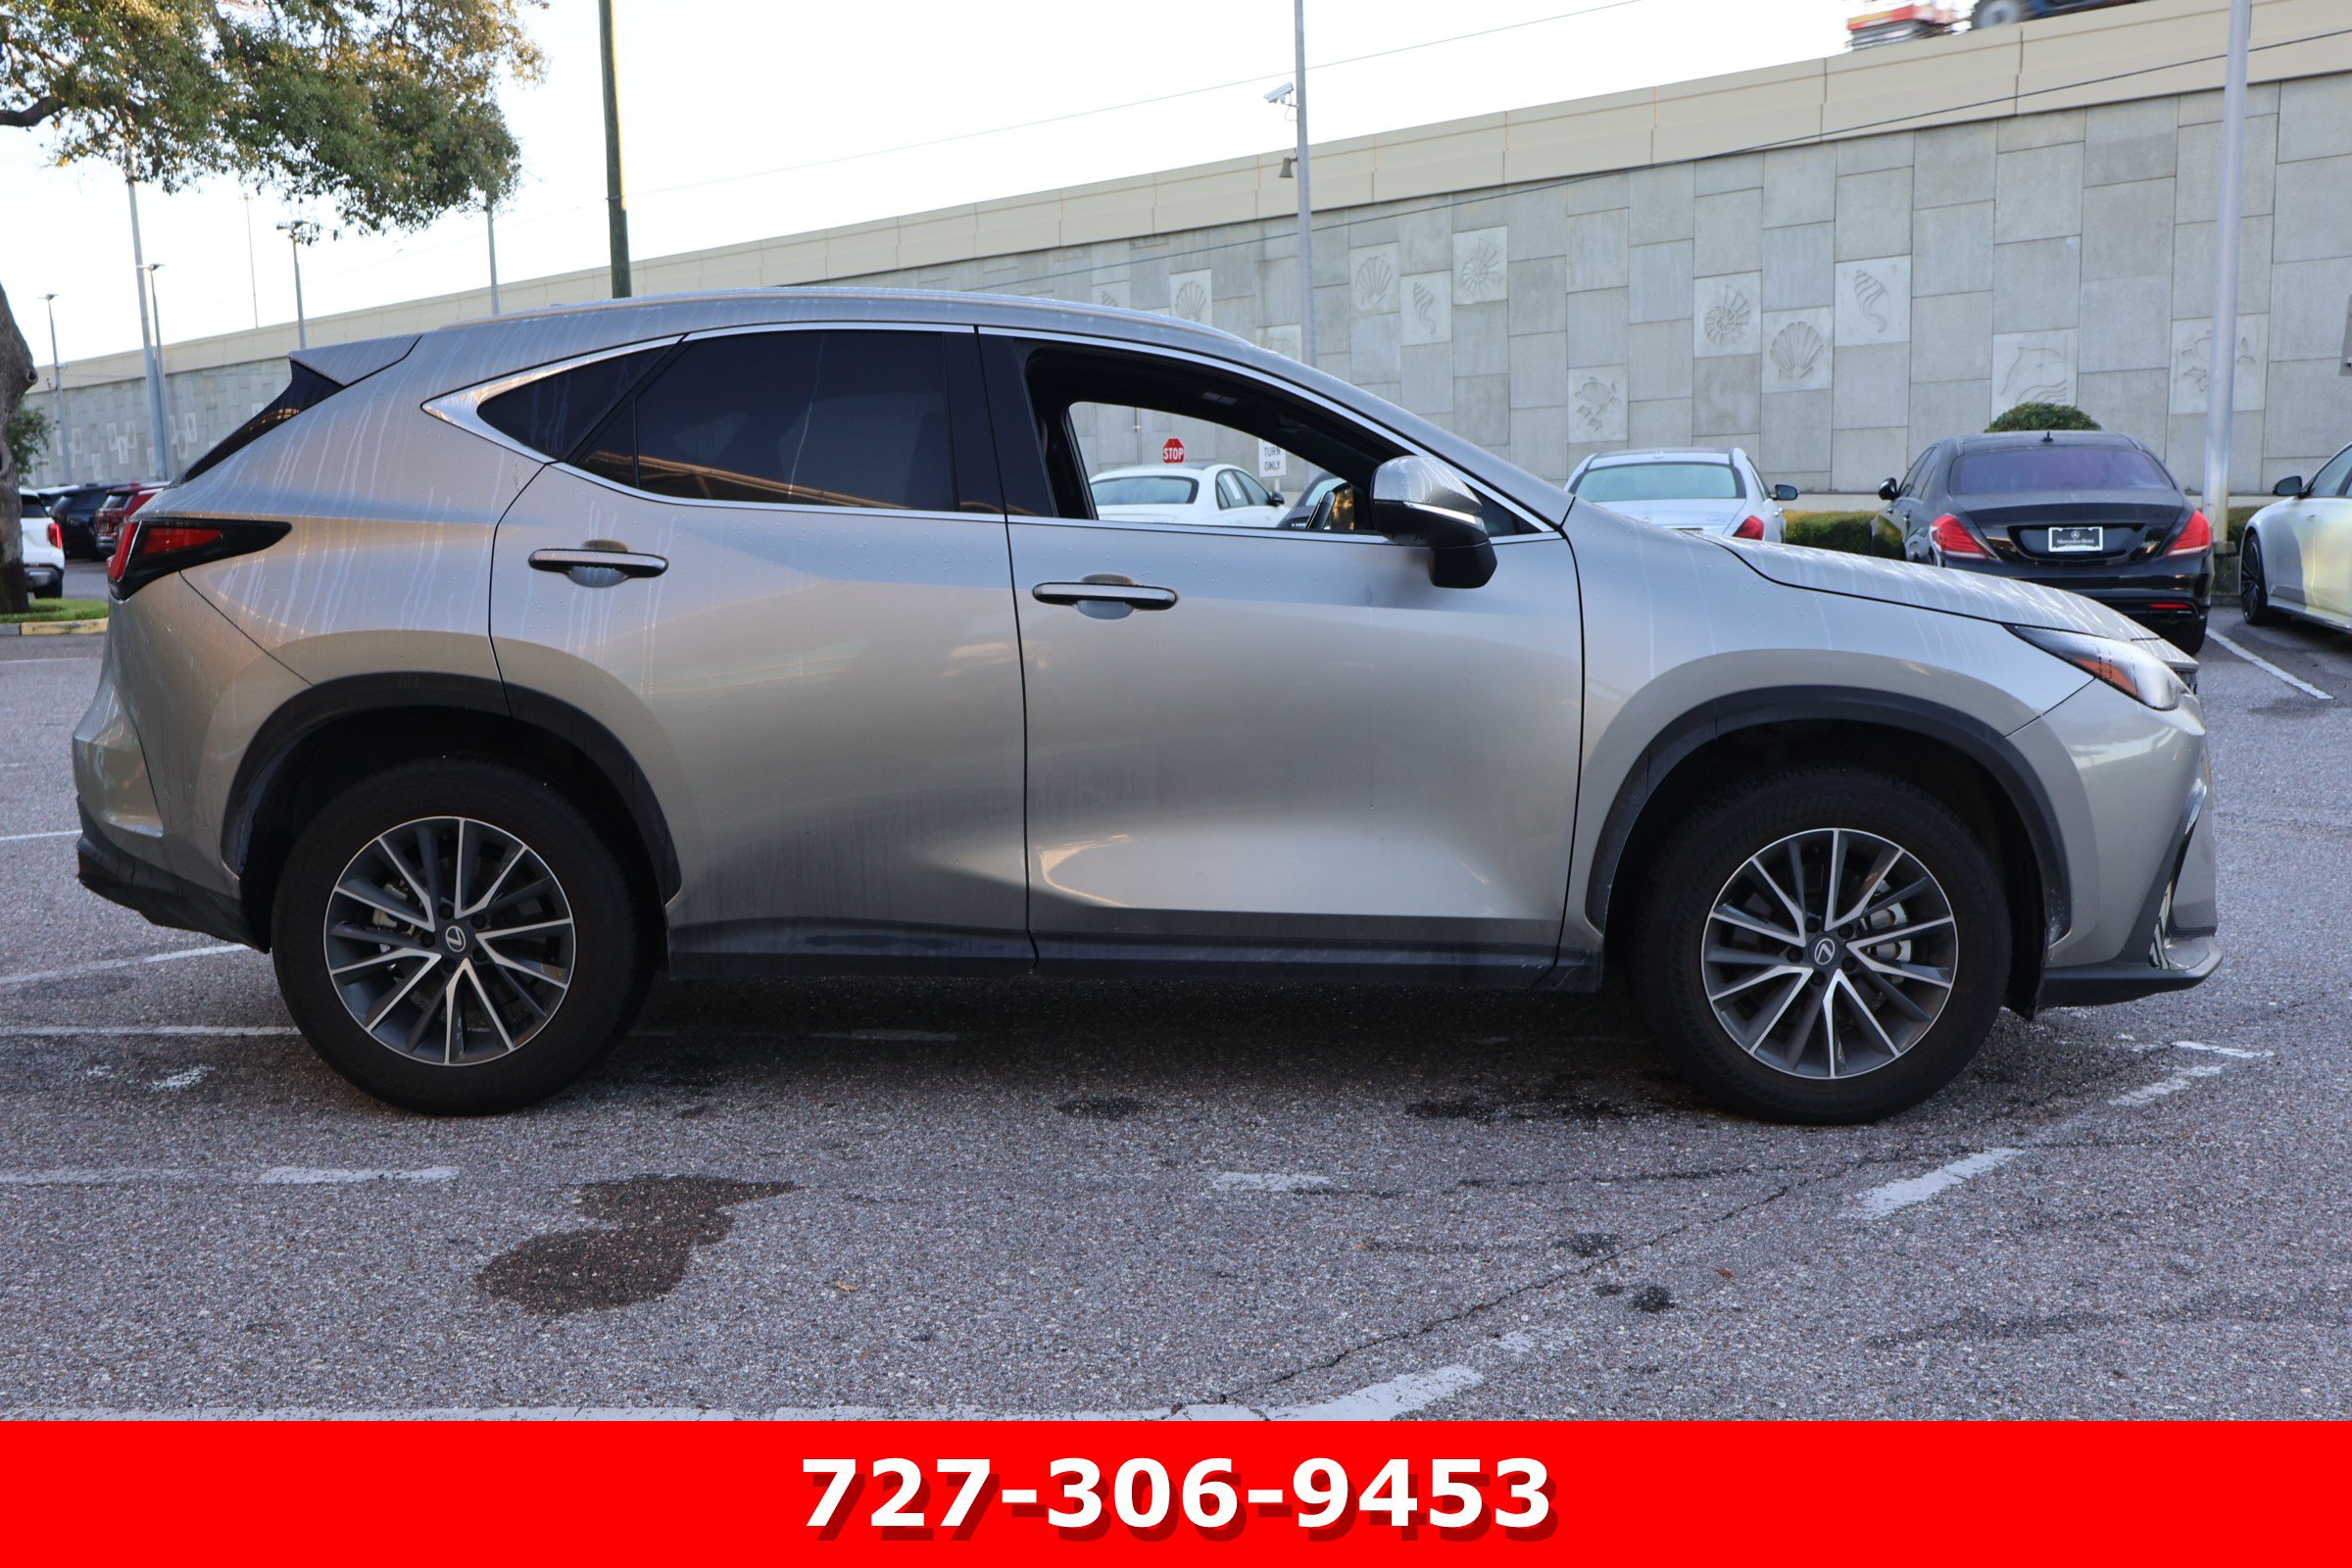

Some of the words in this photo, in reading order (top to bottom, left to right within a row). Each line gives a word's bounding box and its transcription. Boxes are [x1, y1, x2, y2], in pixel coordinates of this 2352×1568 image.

[1163, 447, 1184, 461] STOP
[1264, 446, 1281, 458] TURN
[1264, 461, 1281, 471] ONLY
